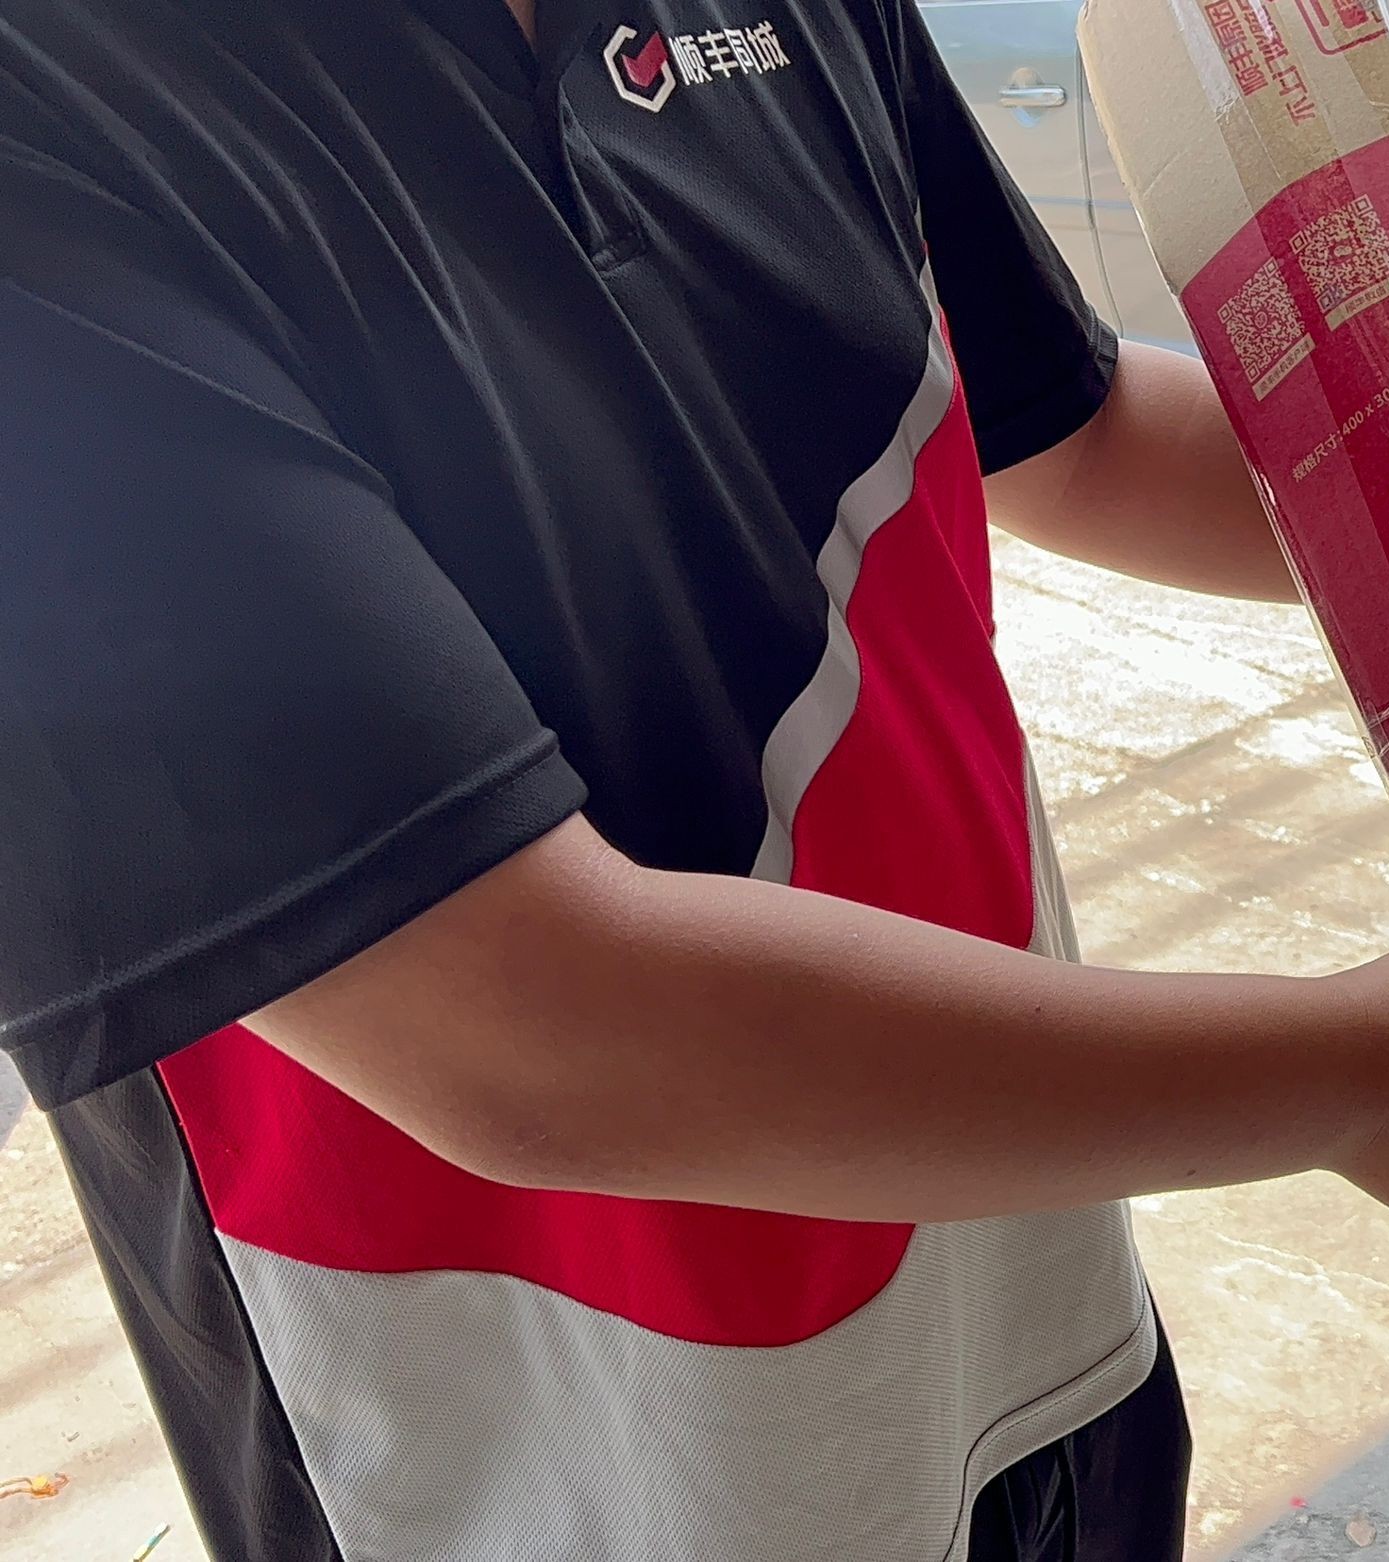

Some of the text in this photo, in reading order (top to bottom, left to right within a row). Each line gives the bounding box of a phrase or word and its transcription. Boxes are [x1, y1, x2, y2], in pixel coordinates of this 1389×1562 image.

[669, 20, 791, 85] 顺丰同城
[1206, 0, 1268, 96] 顺丰原因
